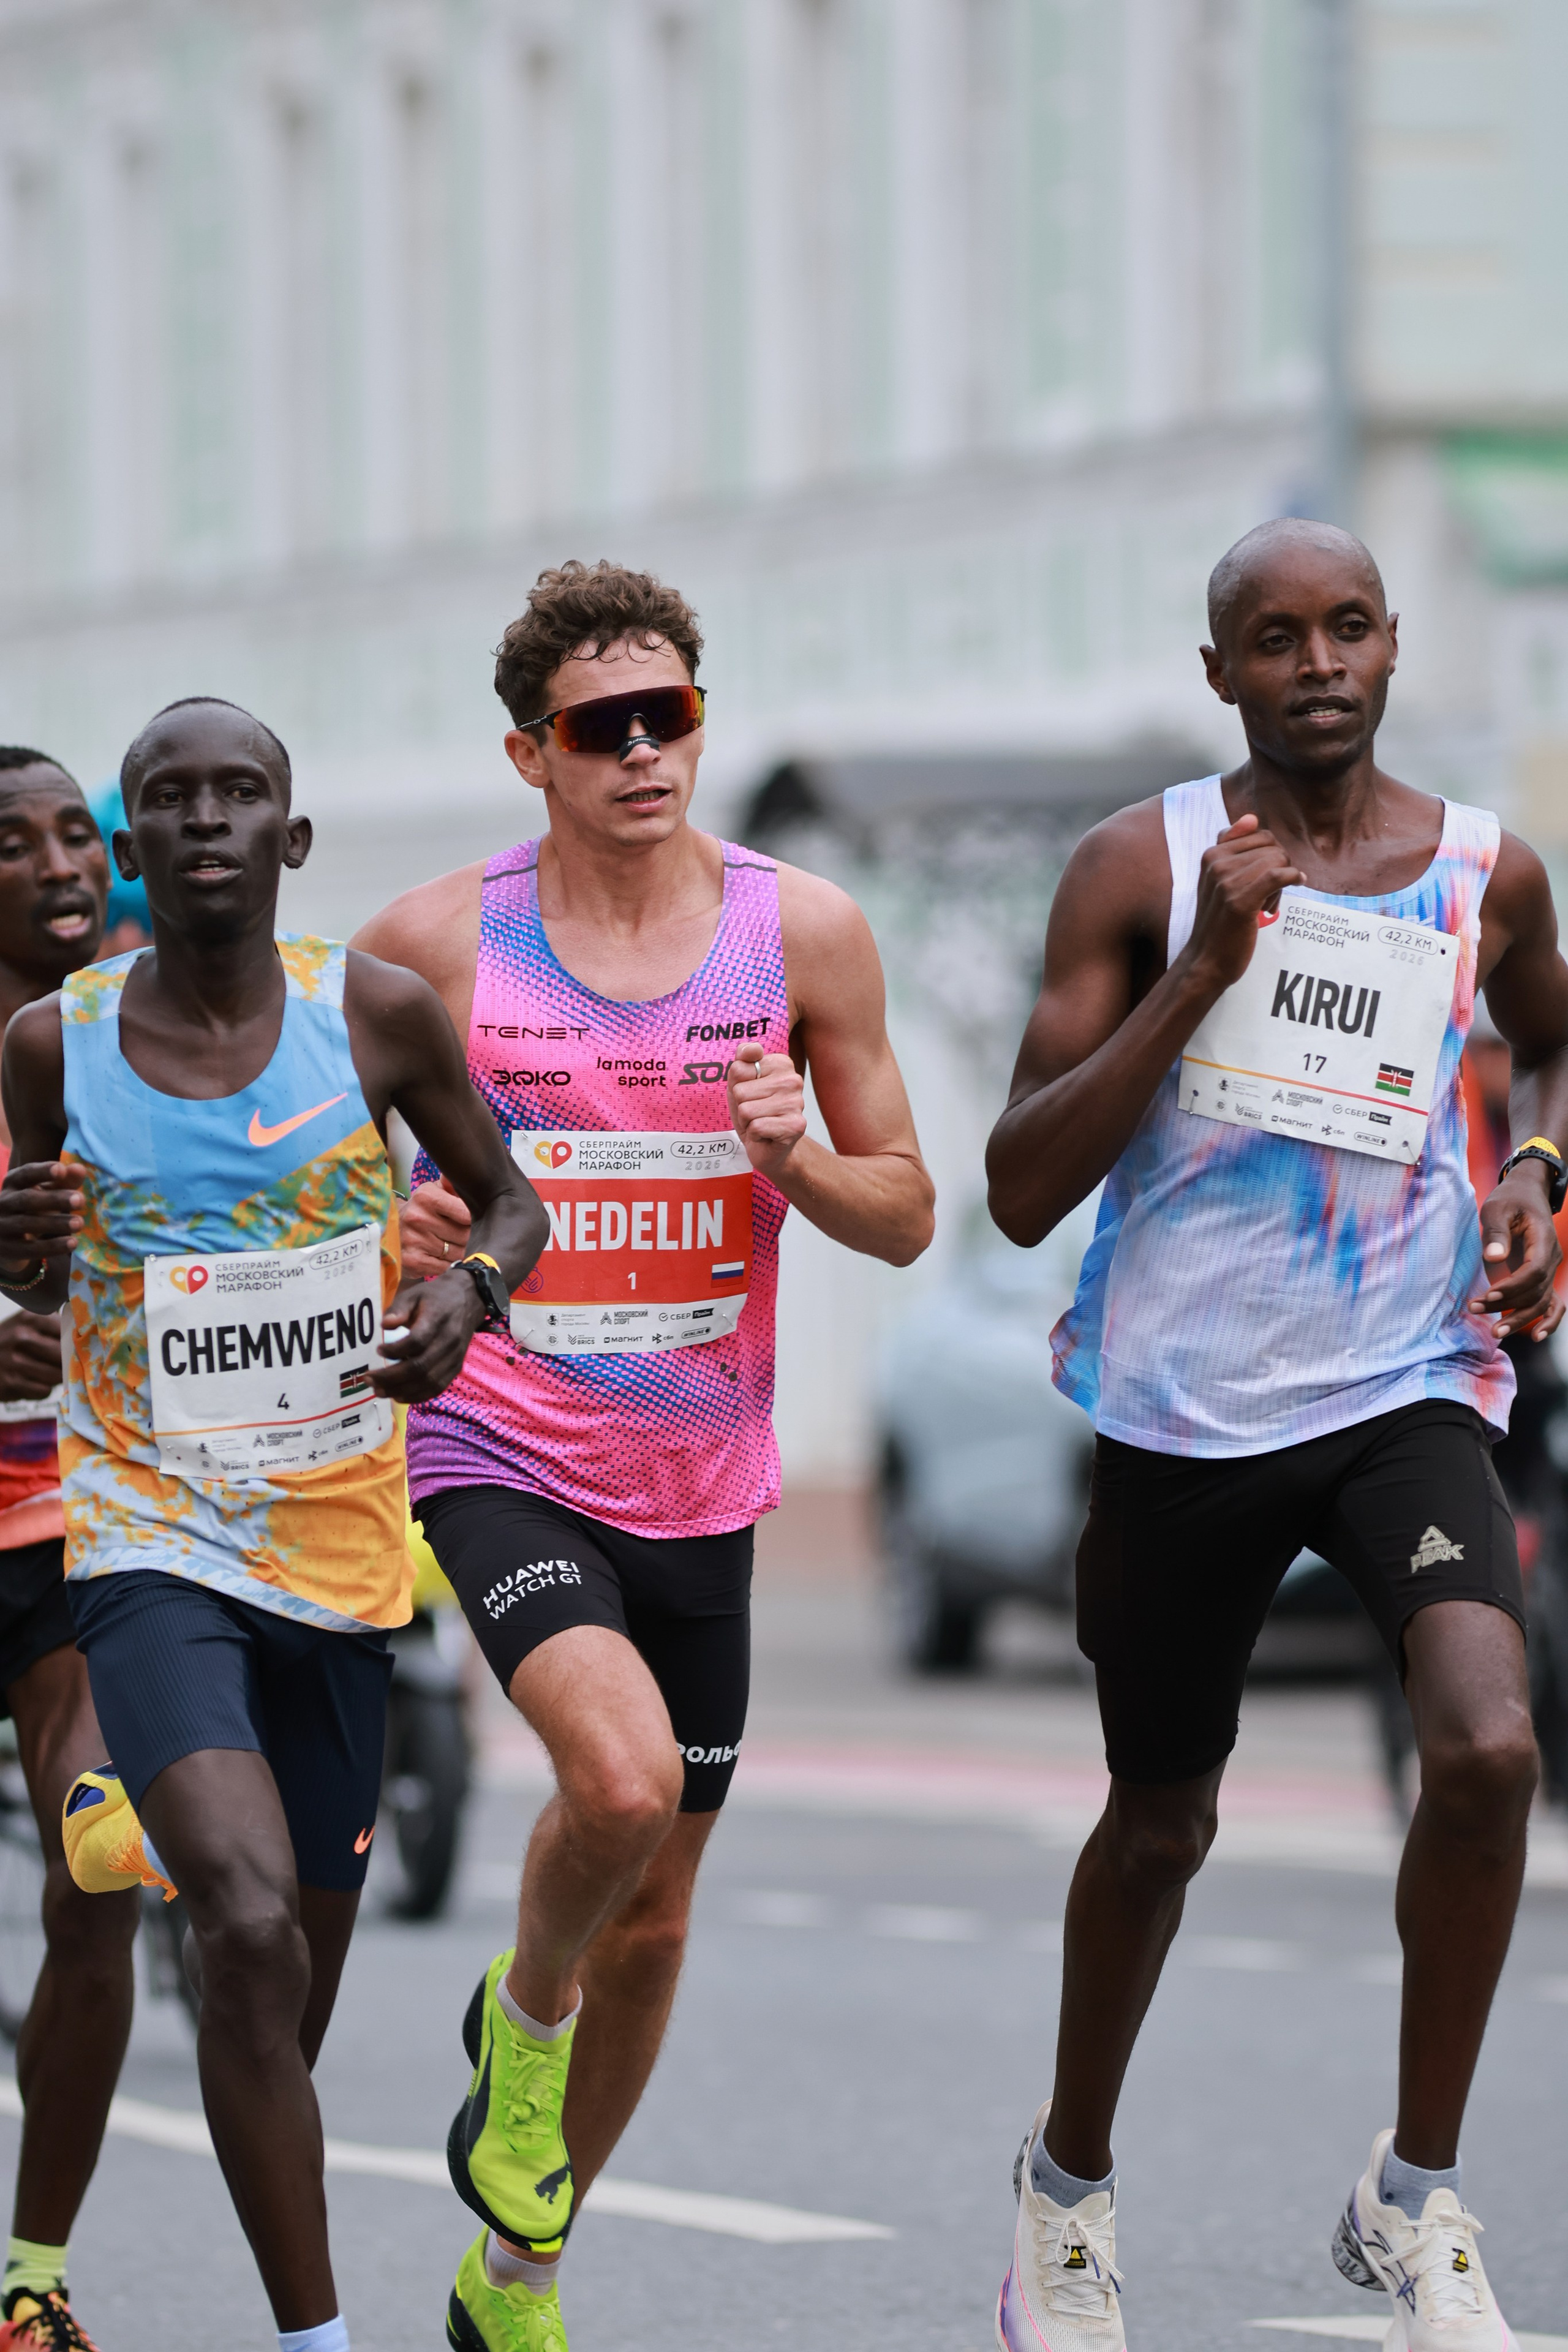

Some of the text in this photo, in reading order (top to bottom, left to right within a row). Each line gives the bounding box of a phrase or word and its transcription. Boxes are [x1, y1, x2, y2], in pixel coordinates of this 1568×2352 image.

[1288, 906, 1349, 925] СБЕРПРАЙМ
[1285, 915, 1370, 942] МОСКОВСКИЙ
[1283, 927, 1344, 948] МАРАФОН
[1385, 931, 1412, 944] 42,2
[1389, 949, 1425, 965] 2026
[1270, 969, 1381, 1038] KIRUI
[477, 1025, 590, 1039] TENET
[686, 1017, 771, 1042] FONBET
[597, 1057, 666, 1071] lamoda
[1303, 1052, 1327, 1074] 17
[618, 1076, 666, 1088] sport
[1243, 1111, 1262, 1120] BRICS
[1345, 1108, 1368, 1118] СБЕР
[579, 1140, 641, 1148] СБЕРПРАЙМ
[1357, 1134, 1380, 1144] WINLINE
[579, 1148, 663, 1159] МОСКОВСКИЙ
[677, 1145, 704, 1156] 42,2
[579, 1161, 641, 1170] МАРАФОН
[685, 1159, 720, 1170] 2026
[543, 1199, 723, 1251] NEDELIN
[316, 1251, 339, 1264] 42,2
[215, 1261, 281, 1271] СБЕРПРАЙМ
[216, 1266, 304, 1283] МОСКОВСКИЙ
[628, 1272, 636, 1289] 1
[217, 1281, 282, 1293] МАРАФОН
[161, 1297, 374, 1376] CHEMWENO
[277, 1393, 290, 1409] 4
[483, 1560, 579, 1609] HUAWEI
[489, 1573, 582, 1619] WATCH GT
